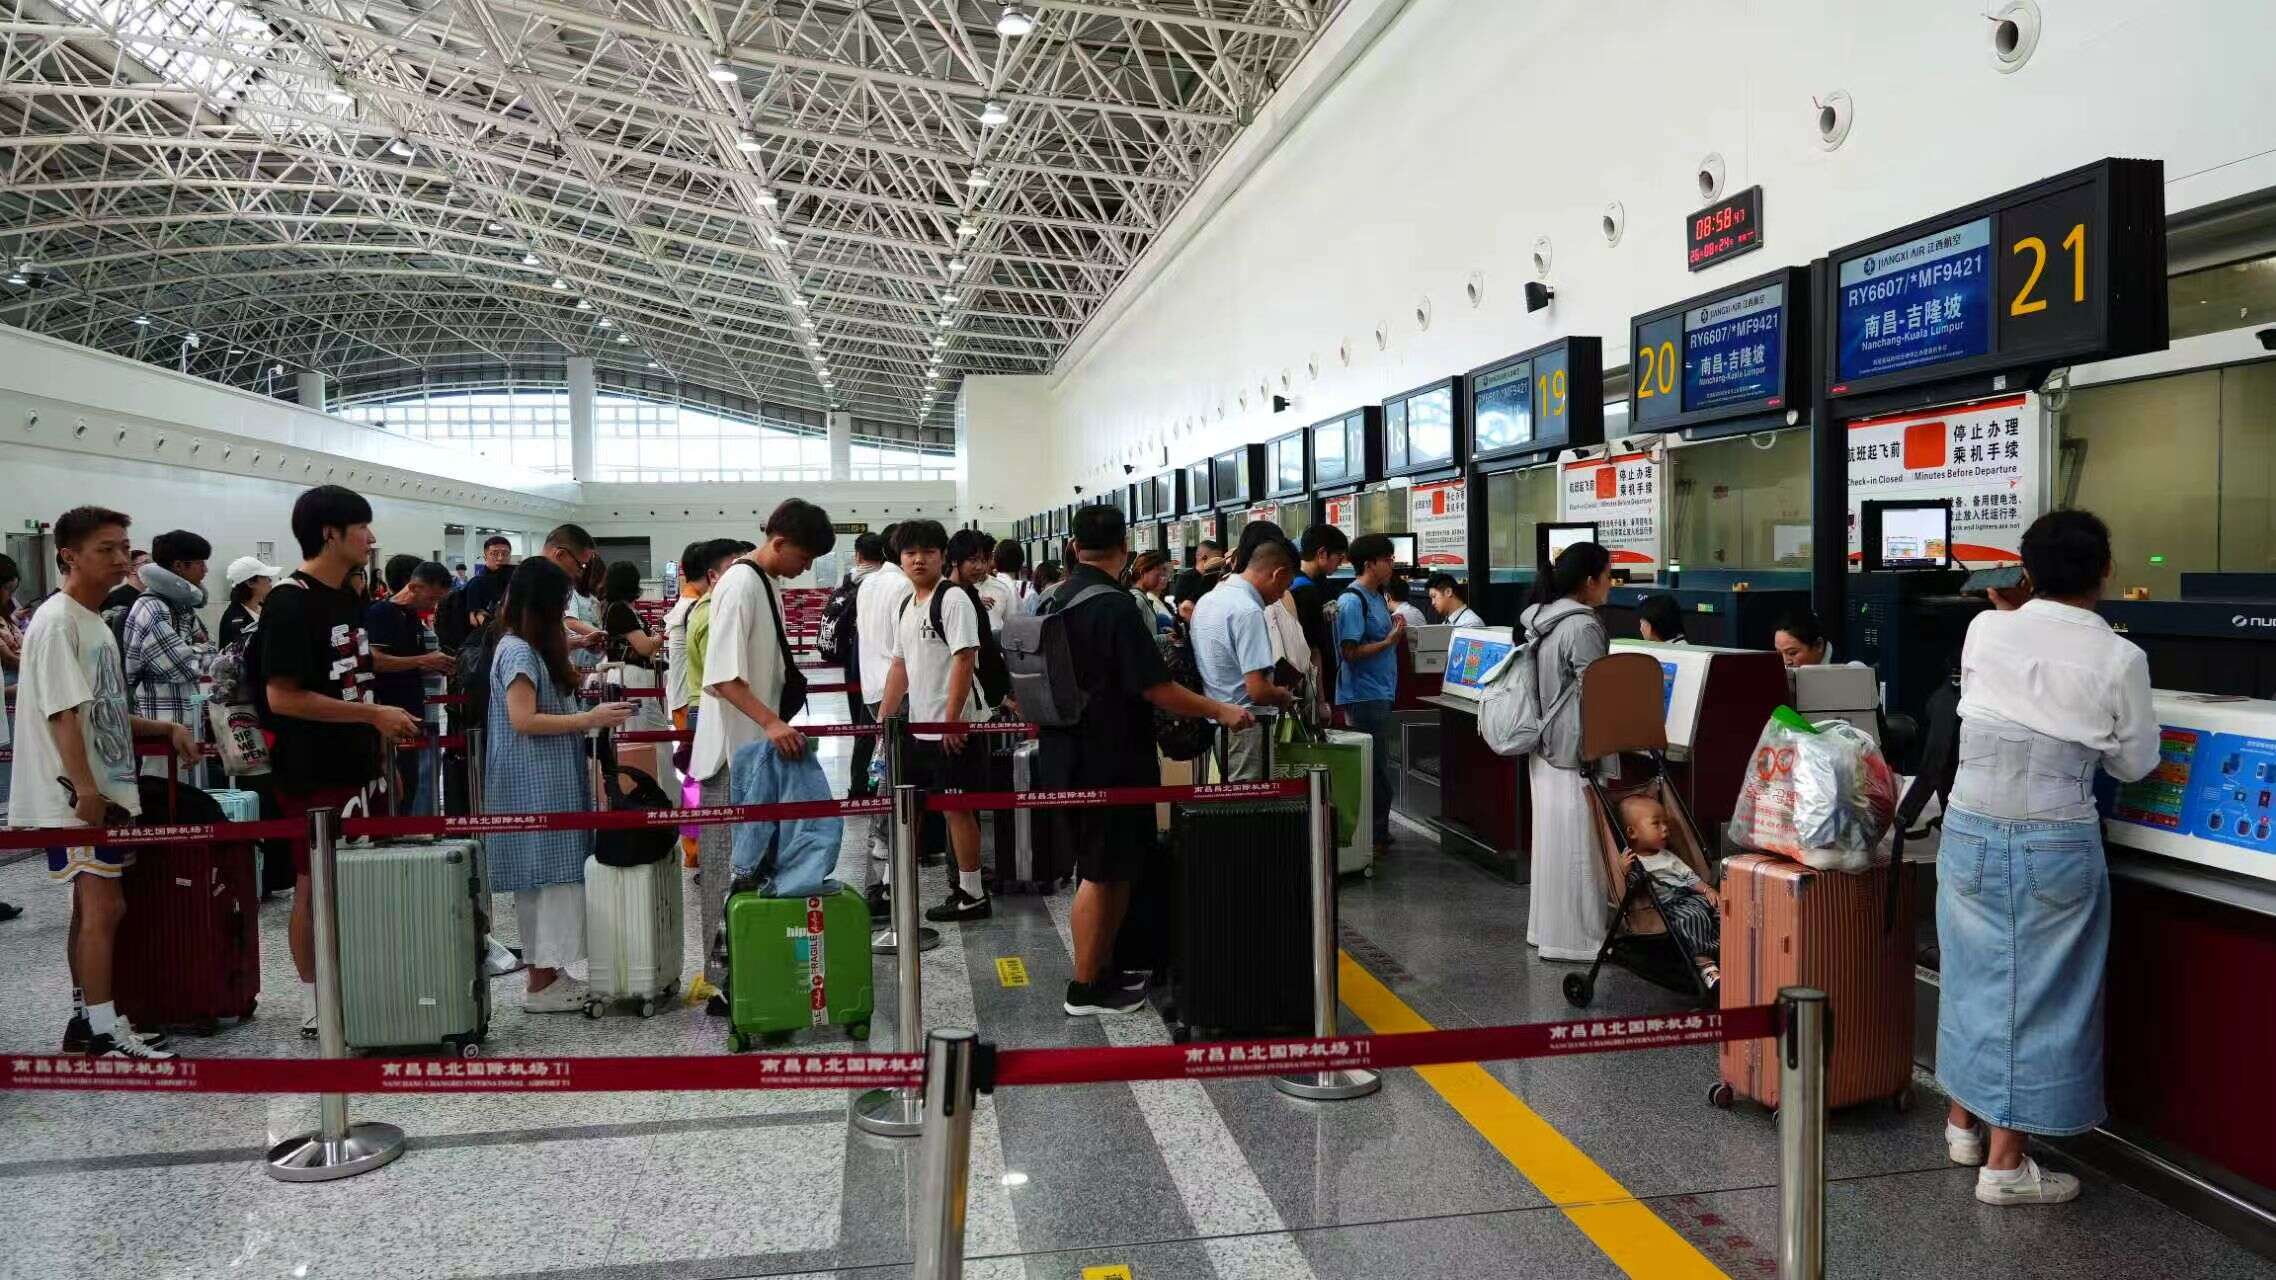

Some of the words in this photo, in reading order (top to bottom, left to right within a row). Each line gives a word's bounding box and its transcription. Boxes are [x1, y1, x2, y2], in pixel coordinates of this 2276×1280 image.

[1695, 207, 1732, 240] 08:58
[1878, 250, 1909, 270] JIANGXI
[1910, 246, 1925, 259] AIR
[2010, 223, 2085, 317] 21
[1864, 293, 1962, 340] 南昌-吉隆坡
[1861, 329, 1928, 351] Nanchang-Kuala
[1930, 320, 1964, 337] Lumpur
[1637, 341, 1676, 399] 20
[1700, 344, 1765, 377] 南昌-吉隆坡
[1538, 369, 1567, 417] 19
[1953, 417, 2019, 443] 停止办理
[1953, 441, 2019, 465] 乘机手续
[1879, 474, 1903, 484] Closed
[1914, 471, 1945, 481] Minutes
[1947, 468, 1973, 478] Before
[1975, 465, 2017, 477] Departure
[1951, 506, 2017, 521] 止放入托运行李
[810, 935, 818, 976] FRAGILE
[1549, 1015, 1703, 1039] 南昌昌北国际机场
[1184, 1041, 1349, 1063] 南昌昌北国际机场
[11, 1059, 175, 1075] 南昌昌北国际机场
[382, 1062, 548, 1076] 南昌昌北国际机场
